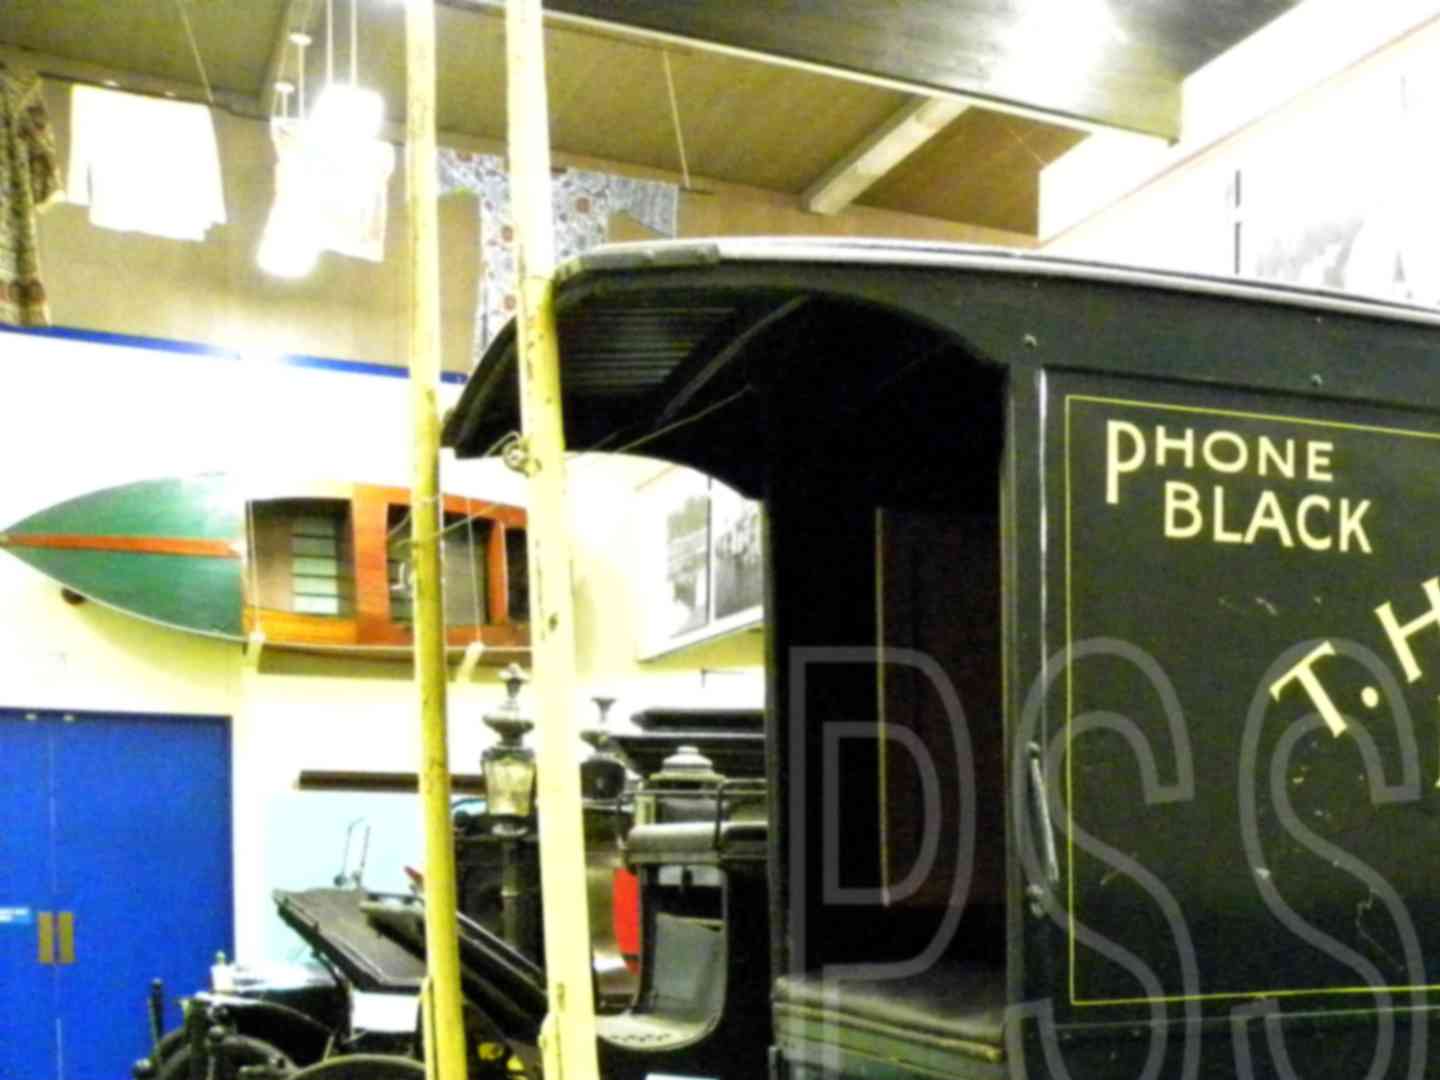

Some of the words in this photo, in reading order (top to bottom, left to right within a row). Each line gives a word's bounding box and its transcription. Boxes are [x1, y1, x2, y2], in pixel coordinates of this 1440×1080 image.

[1105, 418, 1335, 505] PHONE
[1163, 479, 1373, 555] BLACK
[1268, 639, 1380, 738] T.
